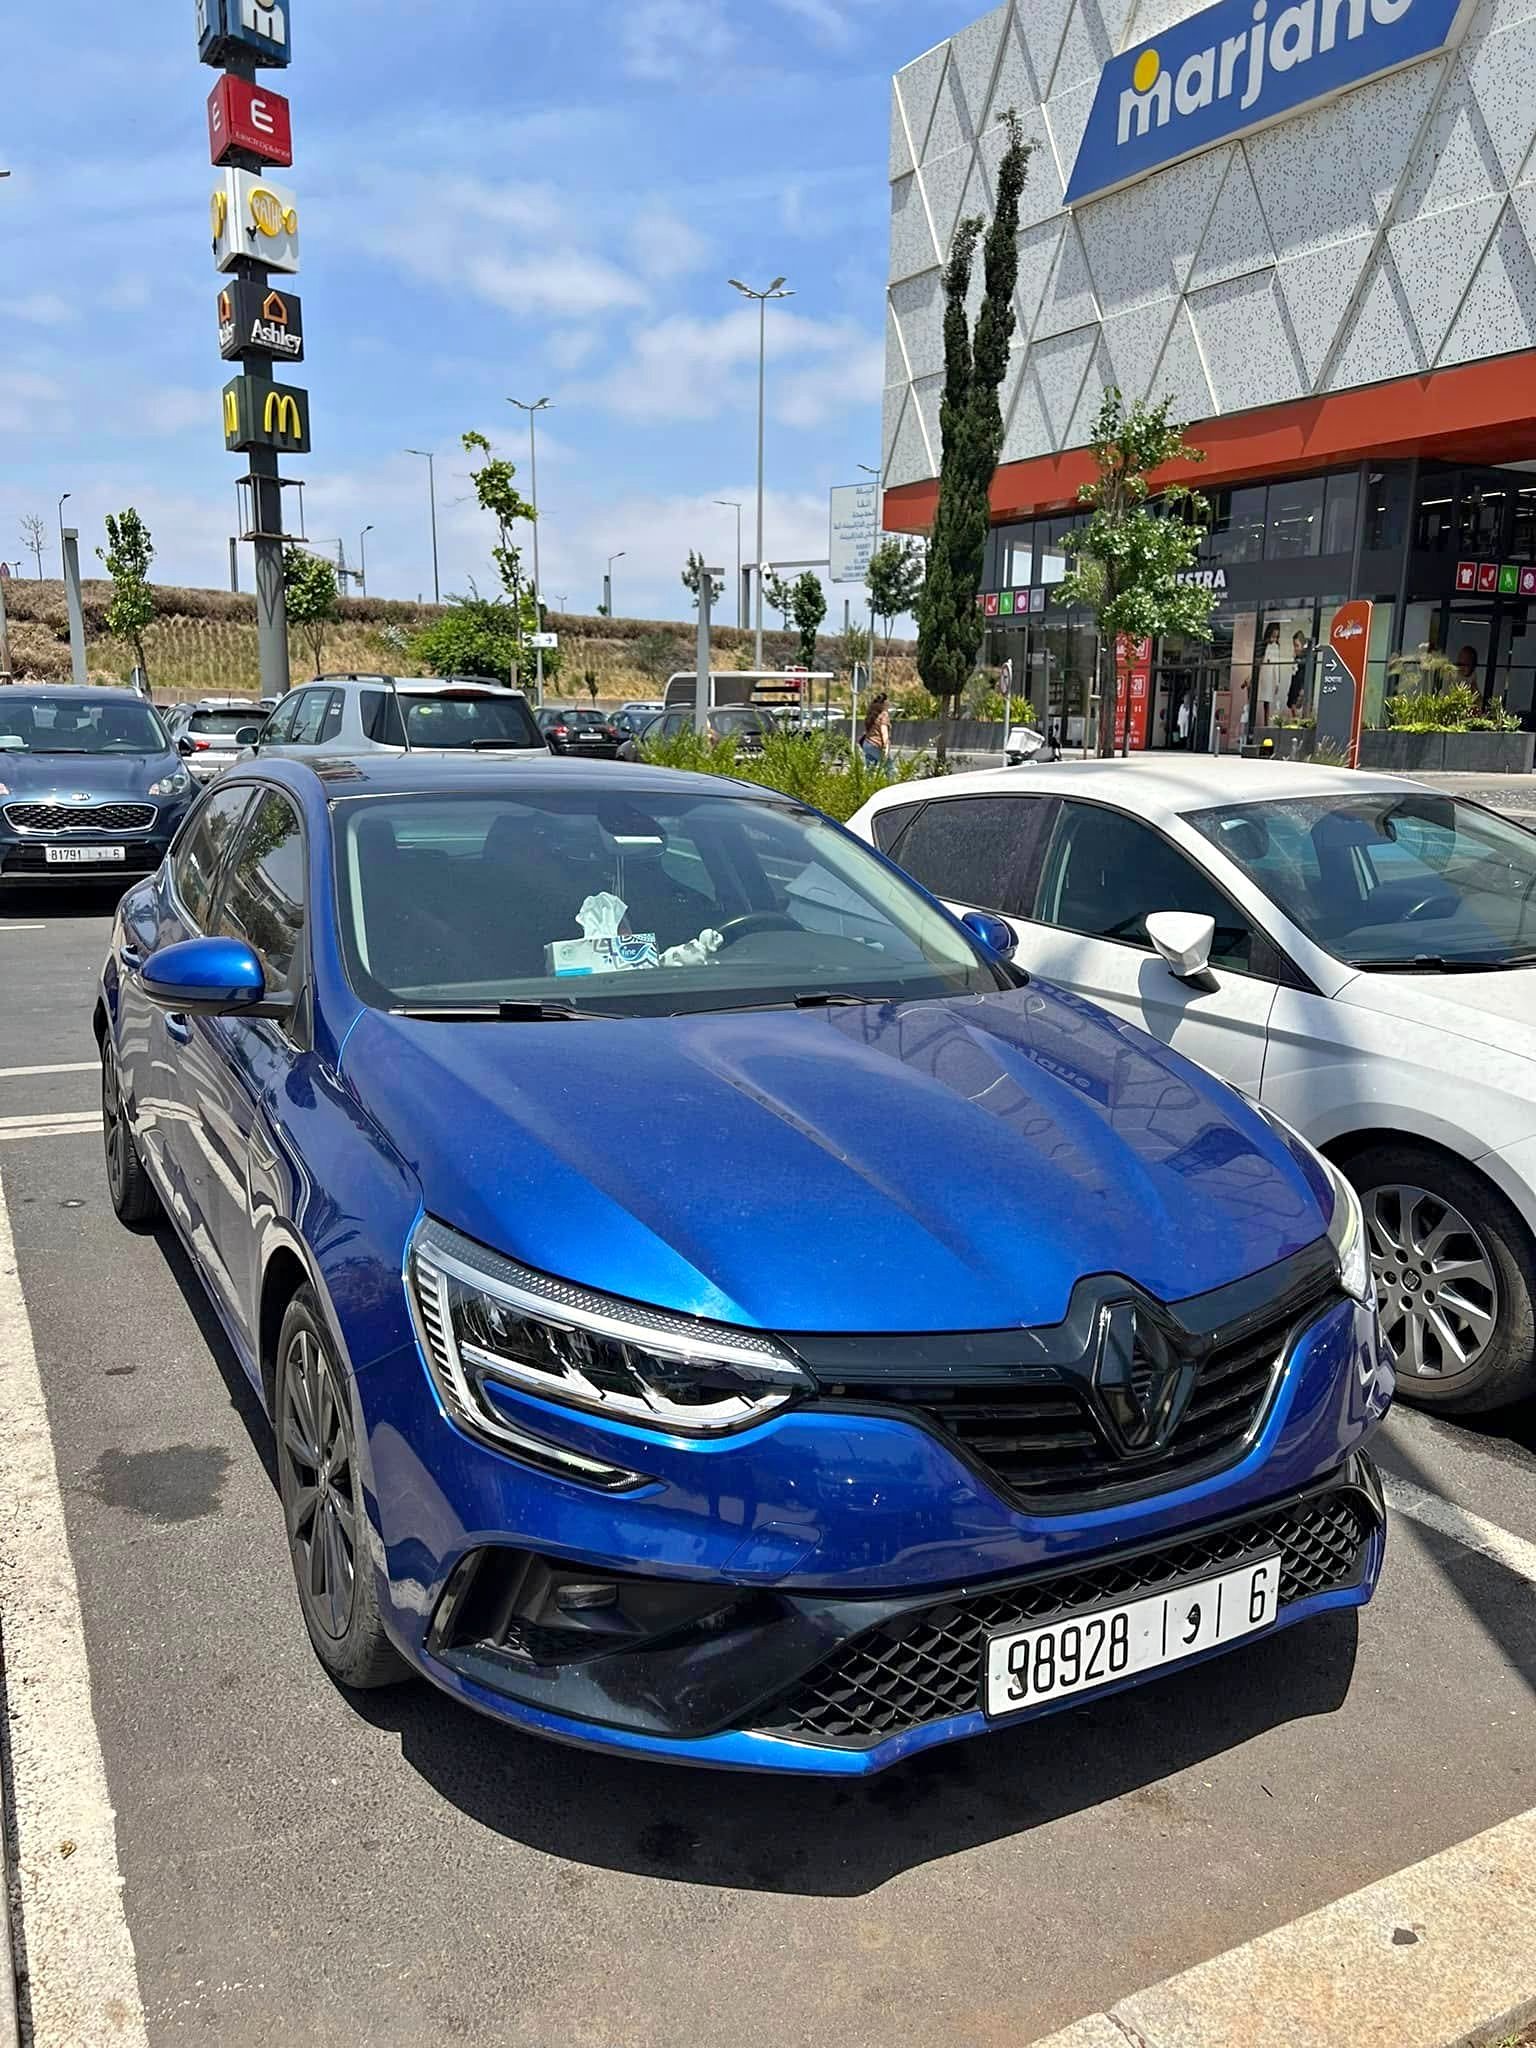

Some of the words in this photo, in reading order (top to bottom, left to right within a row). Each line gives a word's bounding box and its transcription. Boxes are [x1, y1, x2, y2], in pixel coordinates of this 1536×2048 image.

[250, 98, 274, 134] E
[251, 318, 301, 354] Ashley
[51, 849, 81, 861] 81791
[1007, 1612, 1128, 1700] 98928
[1250, 1567, 1267, 1623] 6
